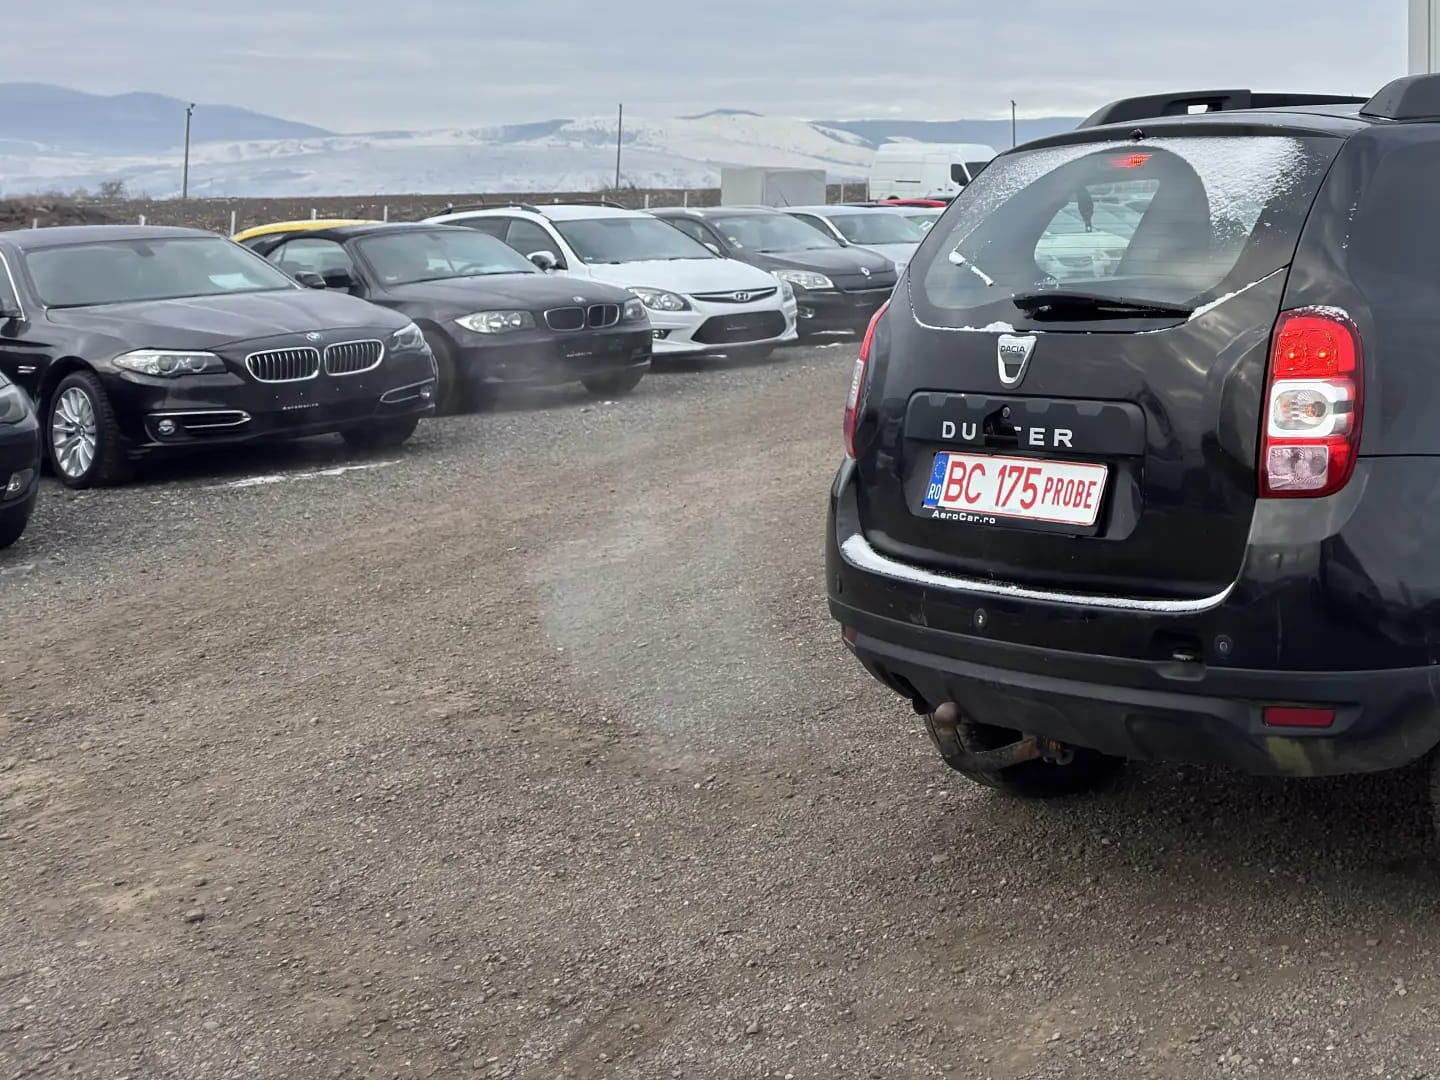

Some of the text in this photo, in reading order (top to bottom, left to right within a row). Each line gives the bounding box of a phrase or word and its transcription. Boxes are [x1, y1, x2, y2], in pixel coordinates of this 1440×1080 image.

[1000, 345, 1025, 353] DACIA
[942, 421, 1072, 448] DUER
[928, 483, 942, 500] RO
[943, 460, 1097, 510] BC 175 PROBE
[931, 510, 996, 524] AeroCar.ro
